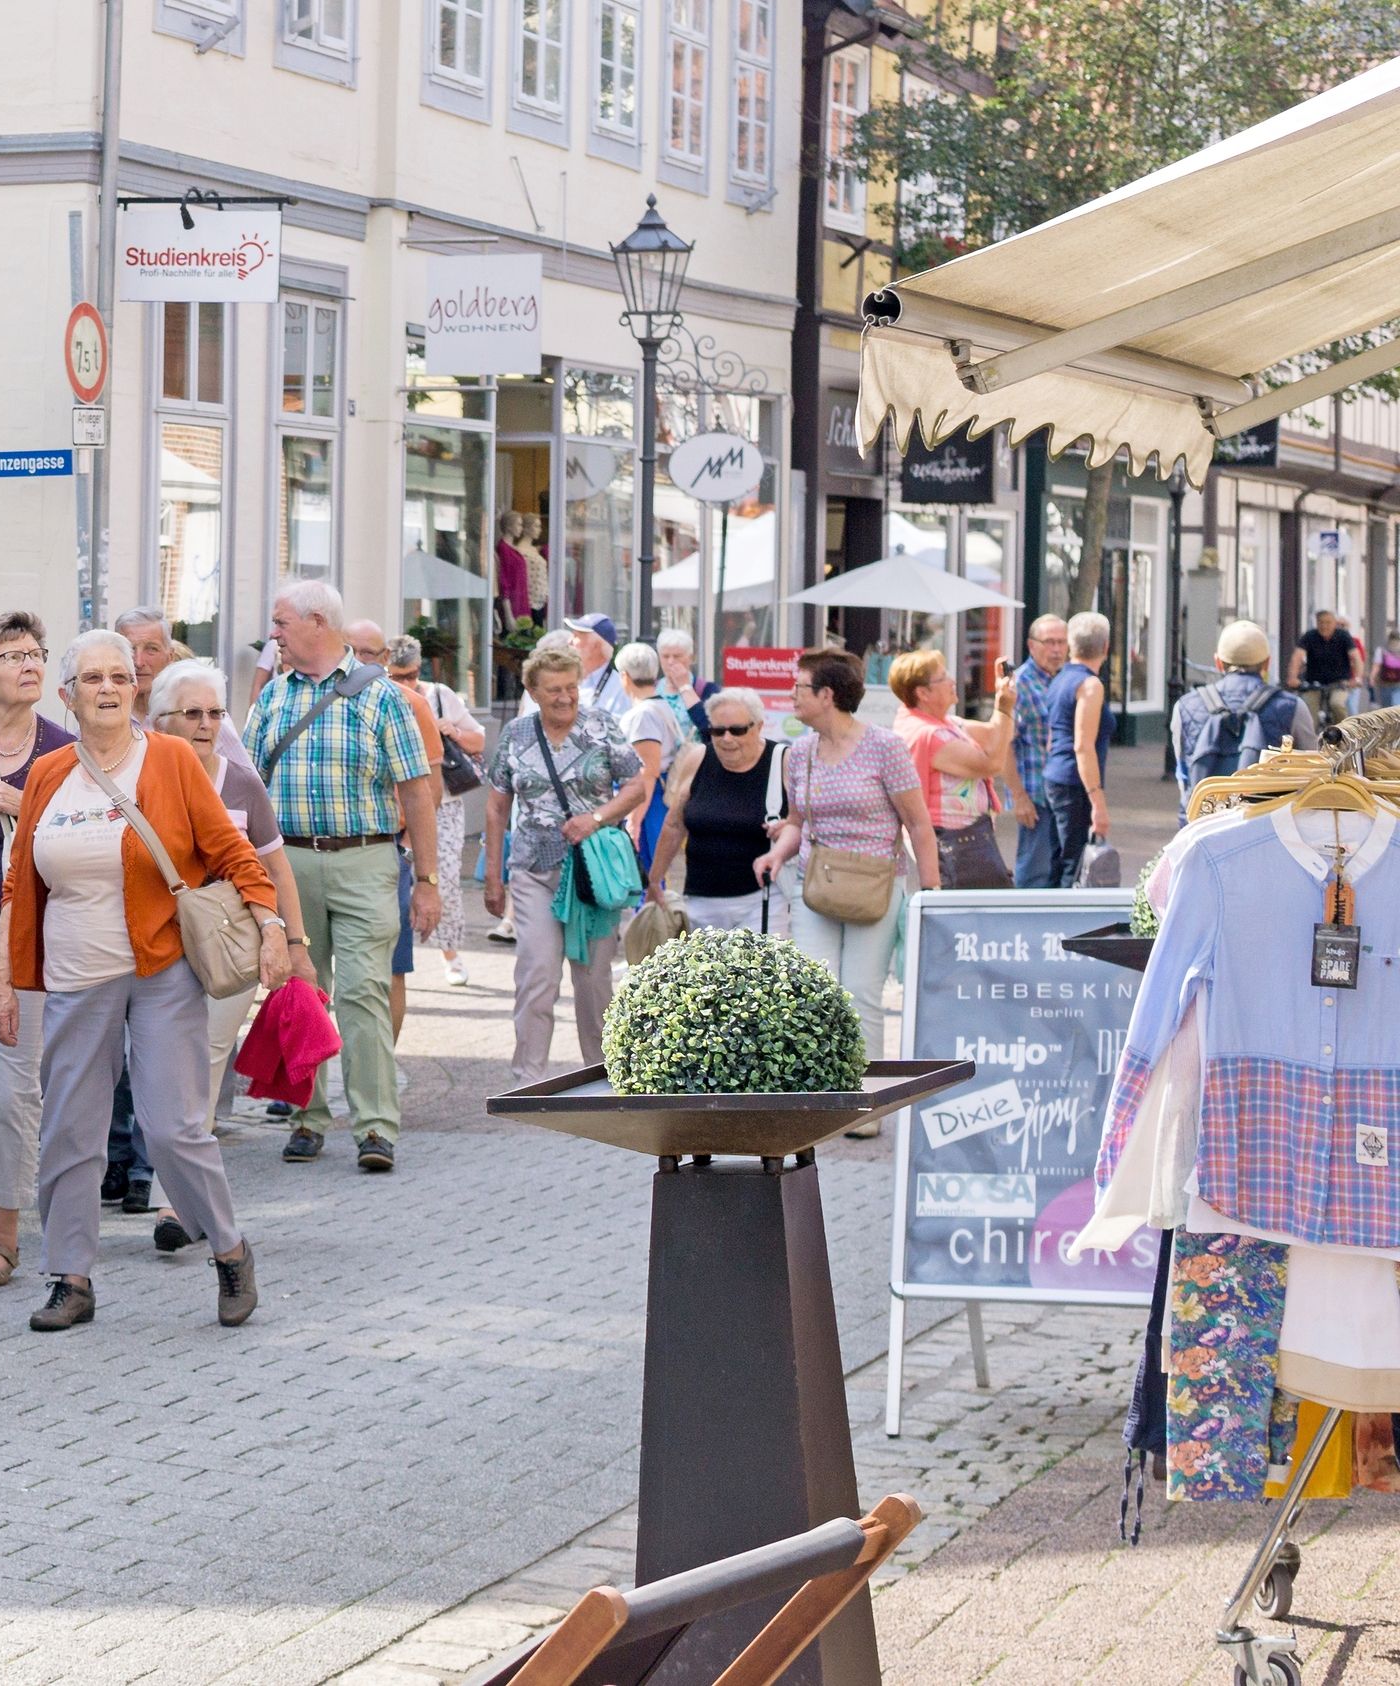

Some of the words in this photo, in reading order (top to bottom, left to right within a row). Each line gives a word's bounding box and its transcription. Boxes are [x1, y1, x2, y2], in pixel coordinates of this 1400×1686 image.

[125, 247, 247, 267] Studienkreis
[139, 268, 201, 278] Profi-Nachhilfe
[204, 267, 215, 278] für
[218, 268, 236, 278] alle!
[428, 286, 538, 334] goldberg
[443, 323, 522, 333] WOHNEN
[94, 339, 99, 371] t
[954, 932, 1030, 962] Rock
[1321, 959, 1351, 972] SPARE
[957, 983, 1133, 999] LIEBESKIN
[1030, 1006, 1084, 1018] Berlin
[1018, 1080, 1090, 1089] EATHERWEAR
[932, 1097, 1014, 1137] Dixie
[1028, 1167, 1086, 1176] MAURITIUS
[918, 1175, 1035, 1204] NOOSA
